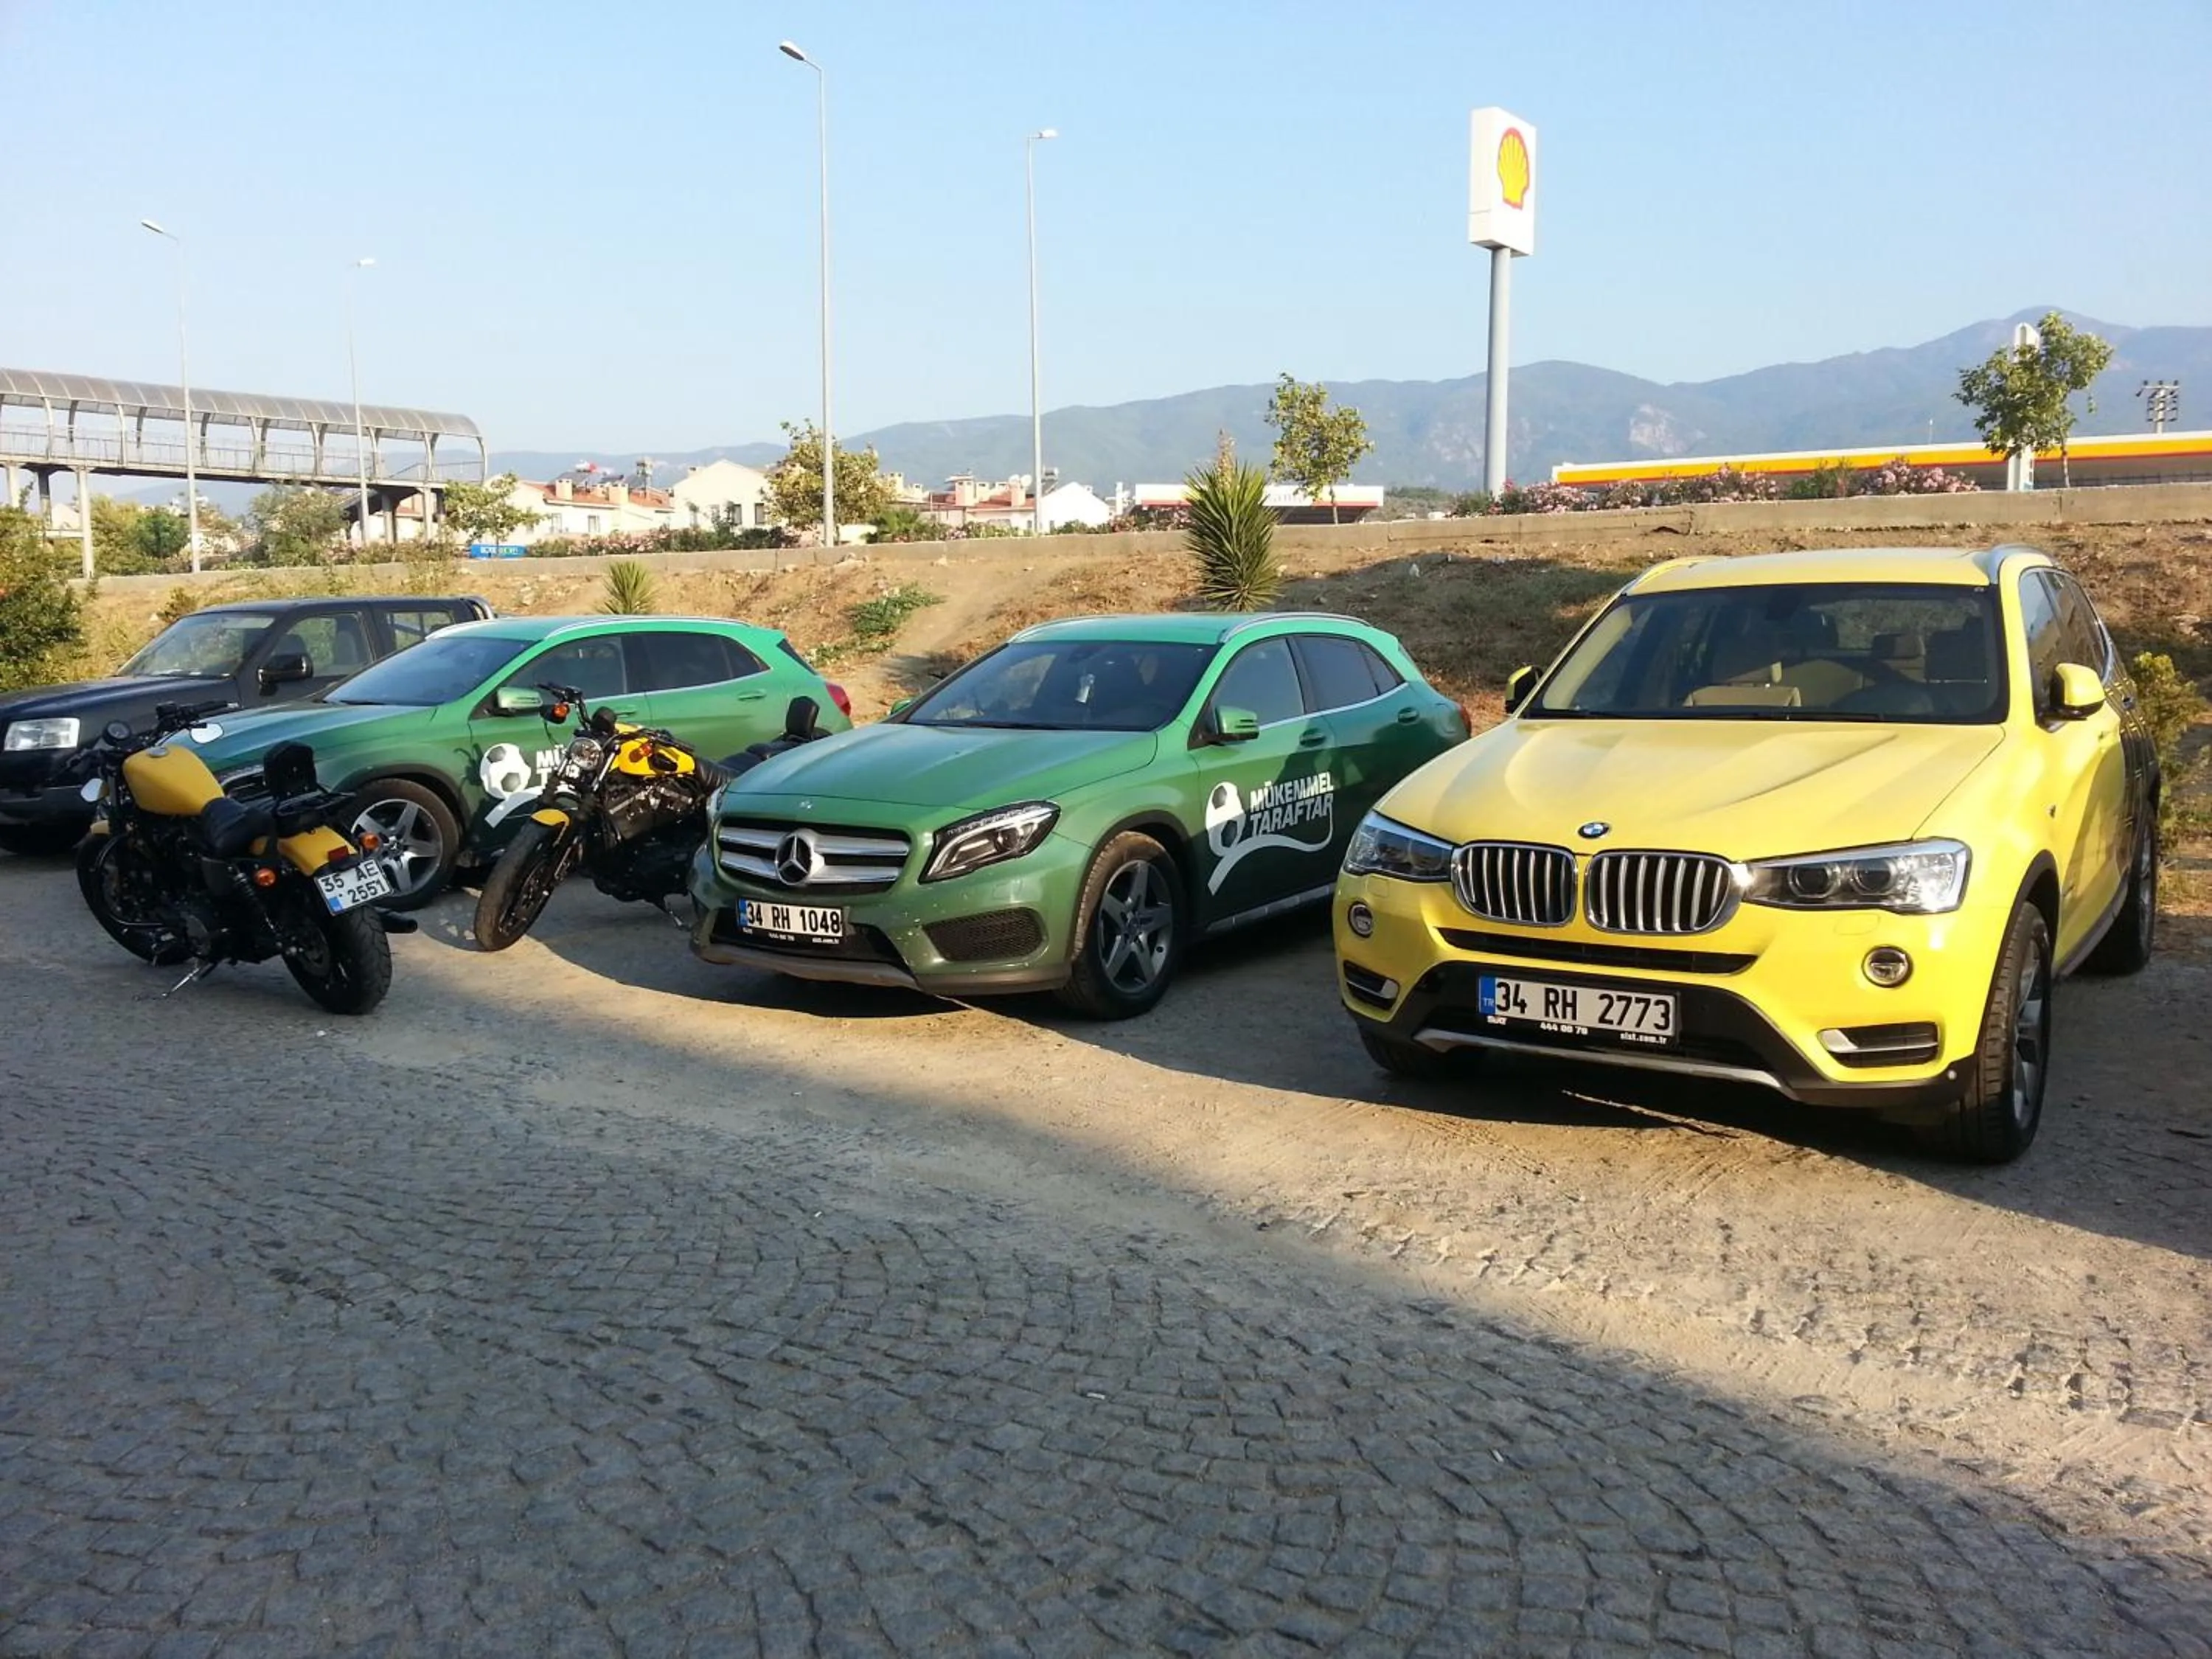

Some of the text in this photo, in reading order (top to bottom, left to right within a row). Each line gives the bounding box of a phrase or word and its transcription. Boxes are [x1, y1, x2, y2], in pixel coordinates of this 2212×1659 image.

[1250, 771, 1334, 813] MÜKEMMEL
[1250, 793, 1334, 836] TARAFTAR
[321, 860, 379, 892] 35 AE
[347, 879, 386, 903] 2551
[747, 902, 762, 926] 34
[771, 906, 790, 929] RH
[799, 909, 841, 933] 1048
[1496, 981, 1670, 1030] 34 RH 2773
